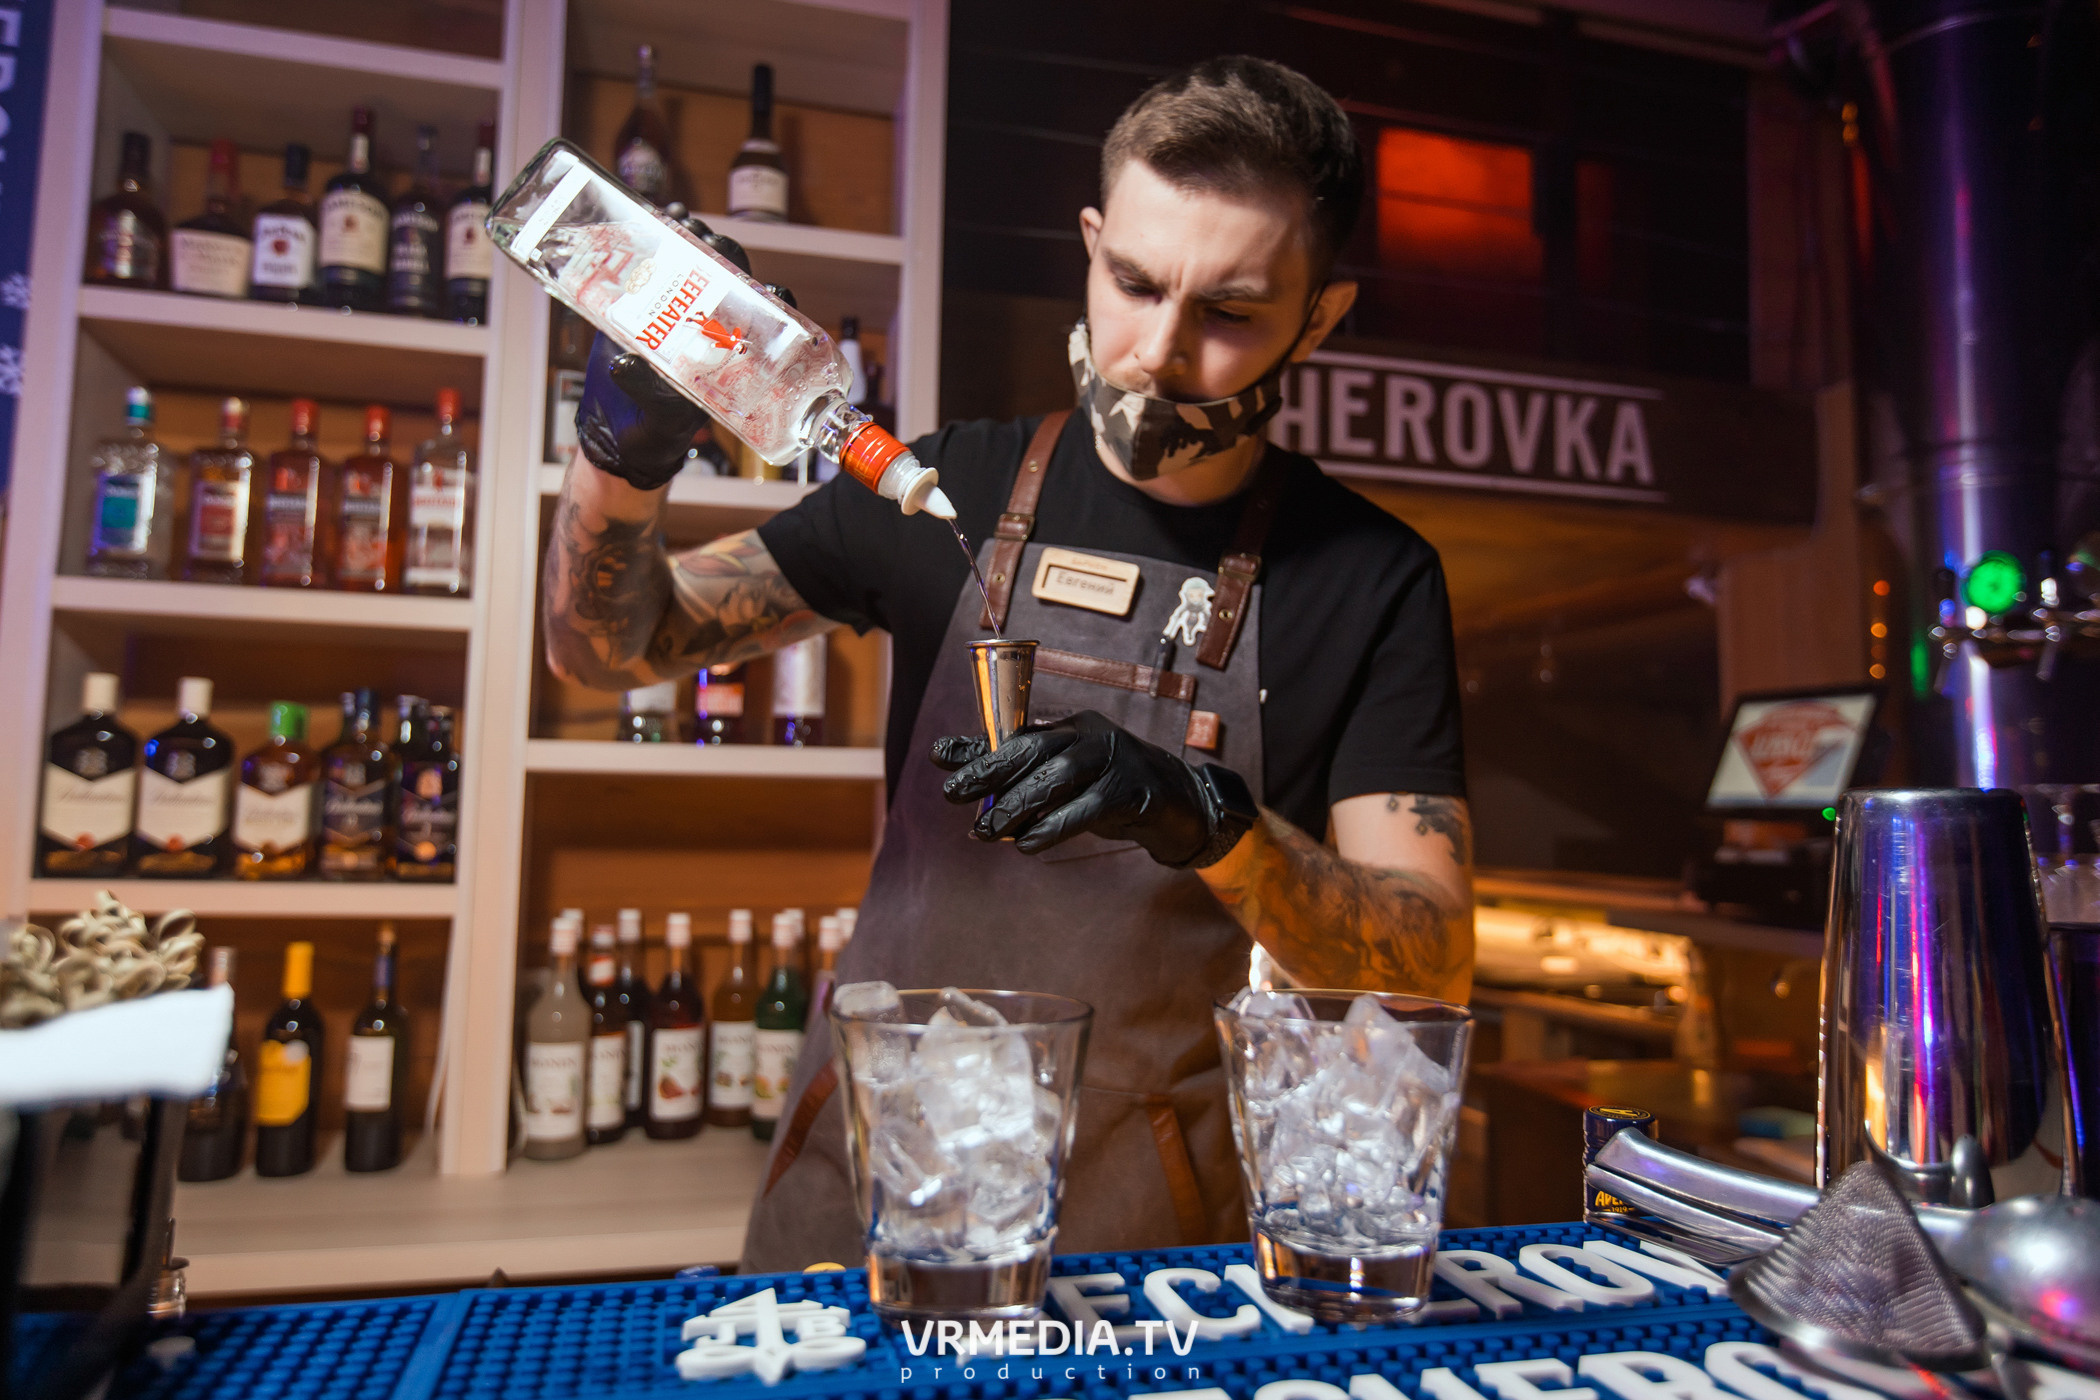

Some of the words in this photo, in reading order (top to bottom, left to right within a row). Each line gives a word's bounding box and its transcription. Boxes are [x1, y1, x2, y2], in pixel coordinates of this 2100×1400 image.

[635, 263, 711, 350] EEFEATER
[648, 272, 684, 318] LONDON
[1595, 1190, 1624, 1207] APE
